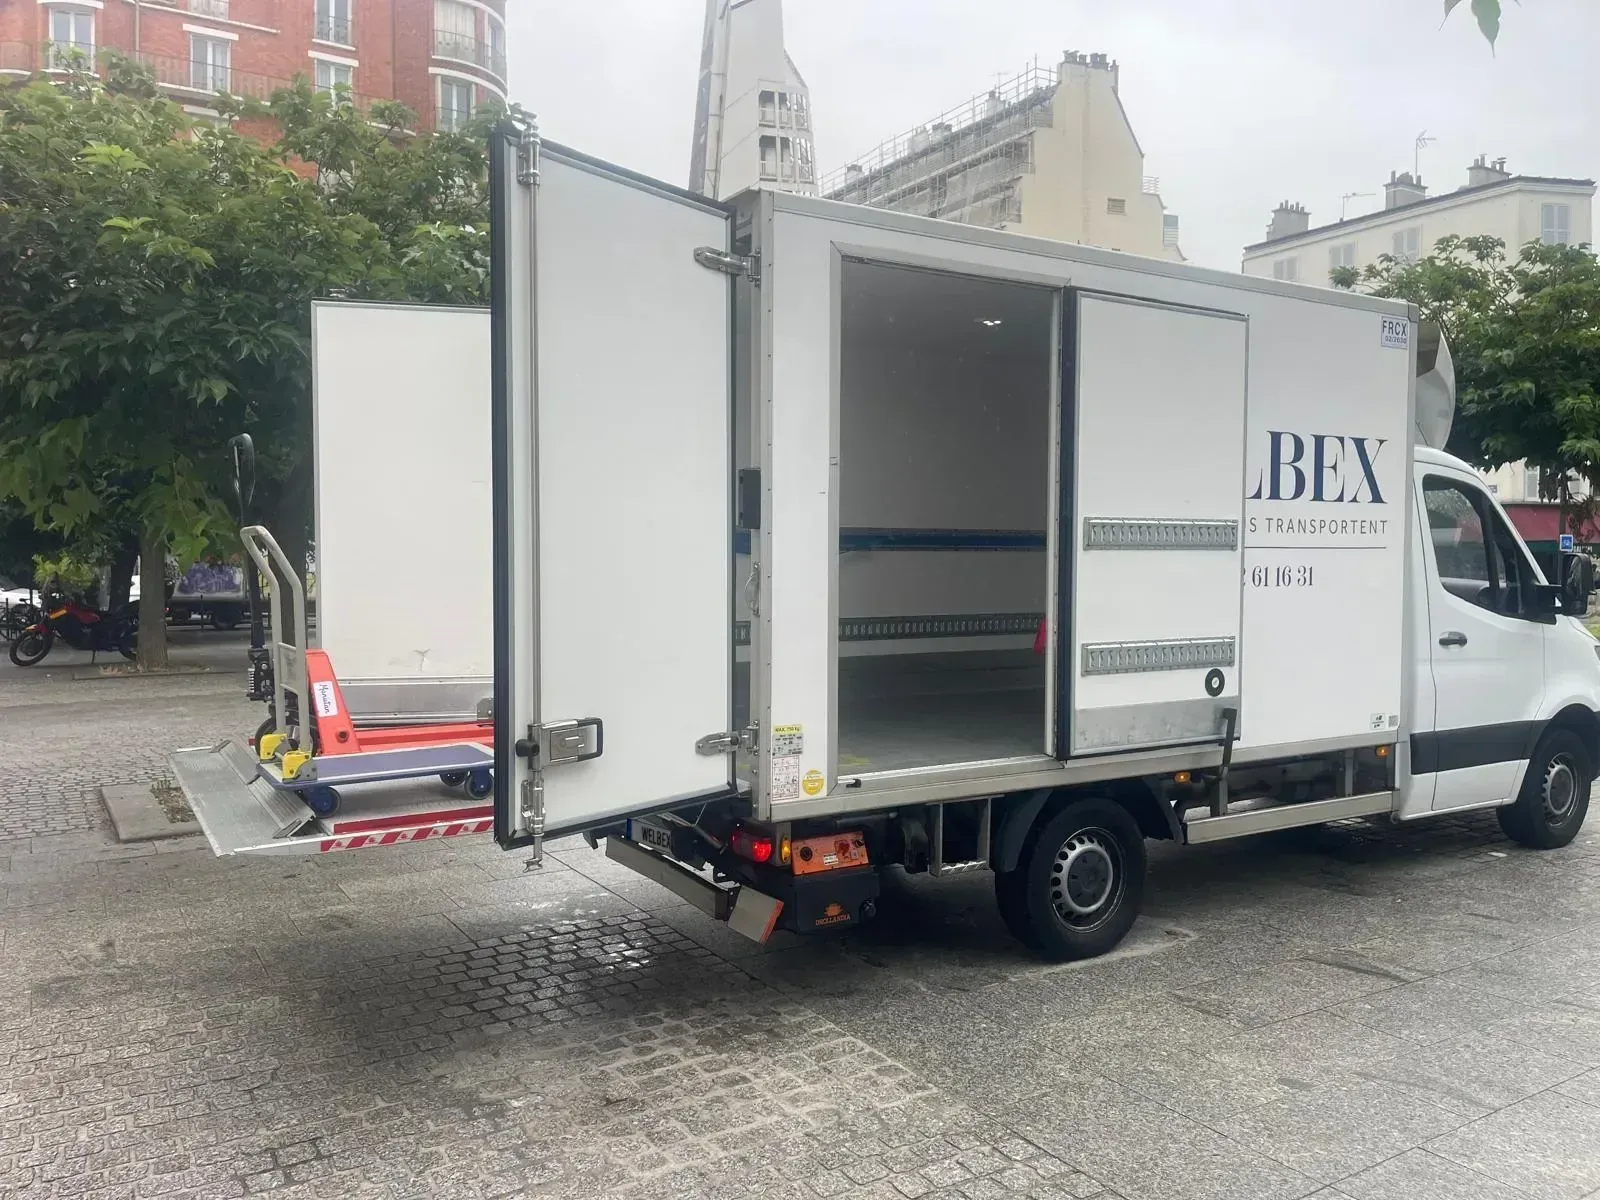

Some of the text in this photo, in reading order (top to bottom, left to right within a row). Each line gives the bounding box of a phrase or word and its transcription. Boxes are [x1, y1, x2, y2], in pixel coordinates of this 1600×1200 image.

[1382, 320, 1407, 337] FRCX
[1265, 517, 1388, 535] TRANSPORTENT
[1252, 565, 1269, 587] 61
[1276, 565, 1292, 587] 16
[1297, 565, 1314, 587] 31
[641, 825, 671, 849] WELBEX
